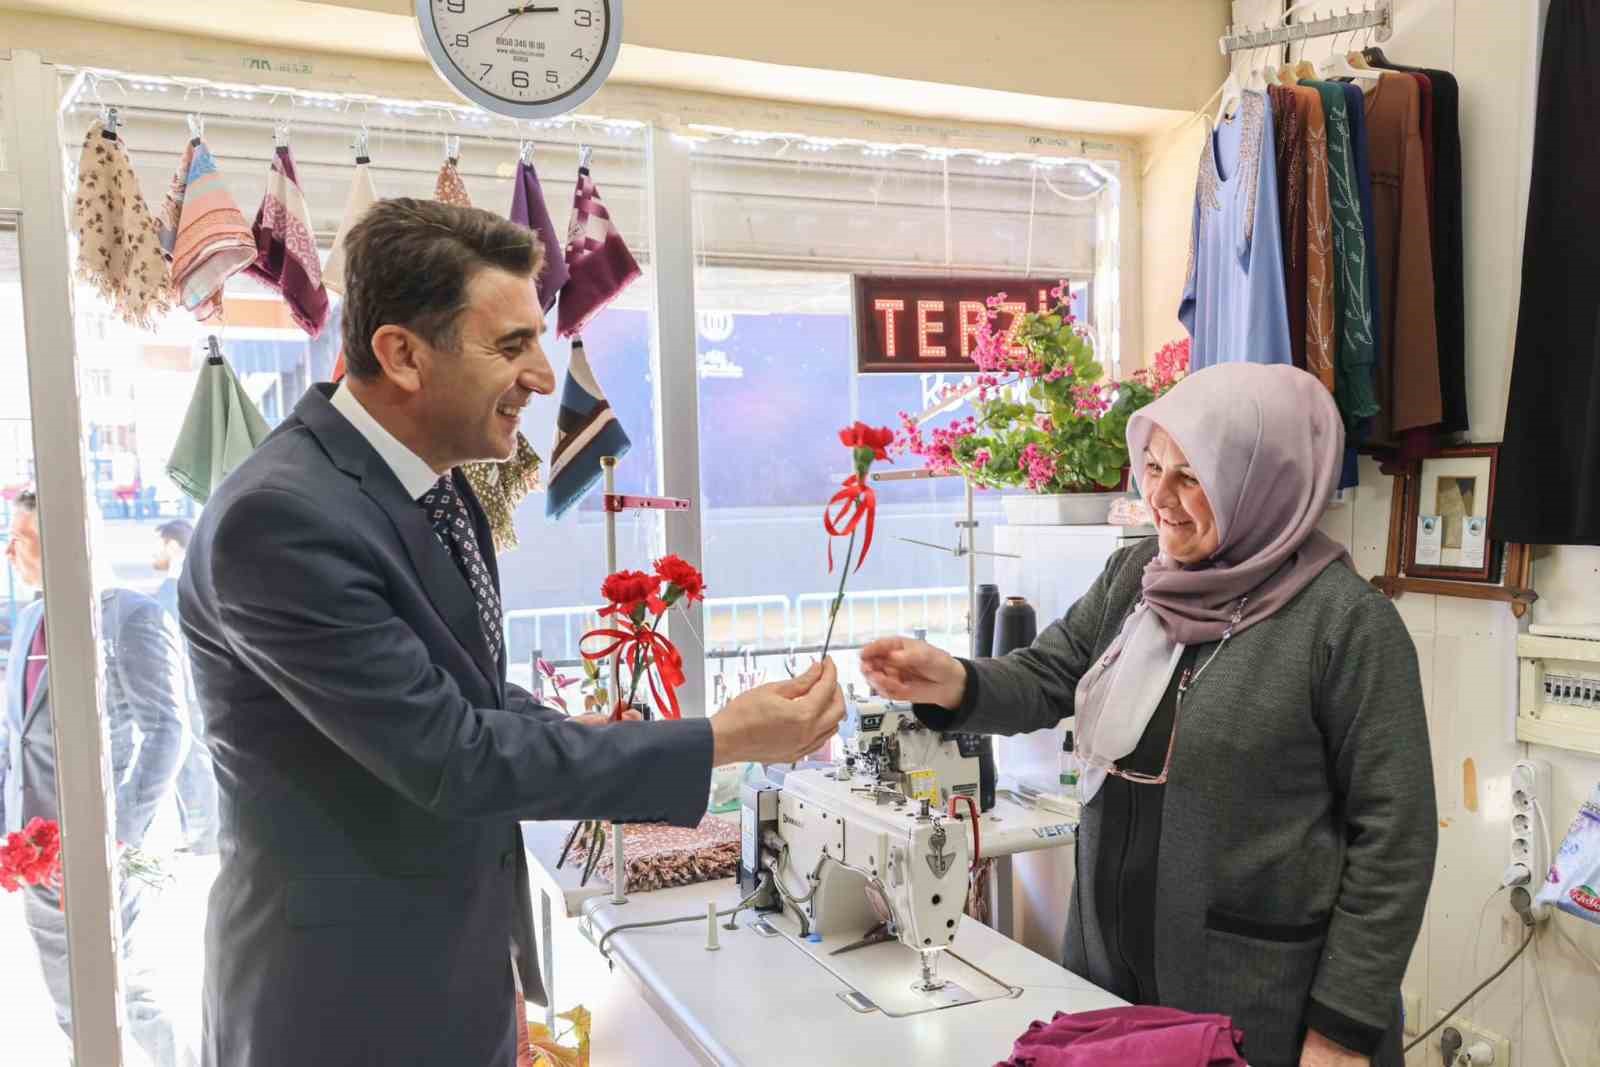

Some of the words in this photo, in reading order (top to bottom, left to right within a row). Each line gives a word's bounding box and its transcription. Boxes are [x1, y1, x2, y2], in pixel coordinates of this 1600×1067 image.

[574, 9, 592, 28] 3
[456, 34, 469, 48] 8
[570, 47, 584, 59] 4
[479, 63, 494, 81] 7
[511, 70, 530, 89] 6
[545, 70, 559, 84] 5
